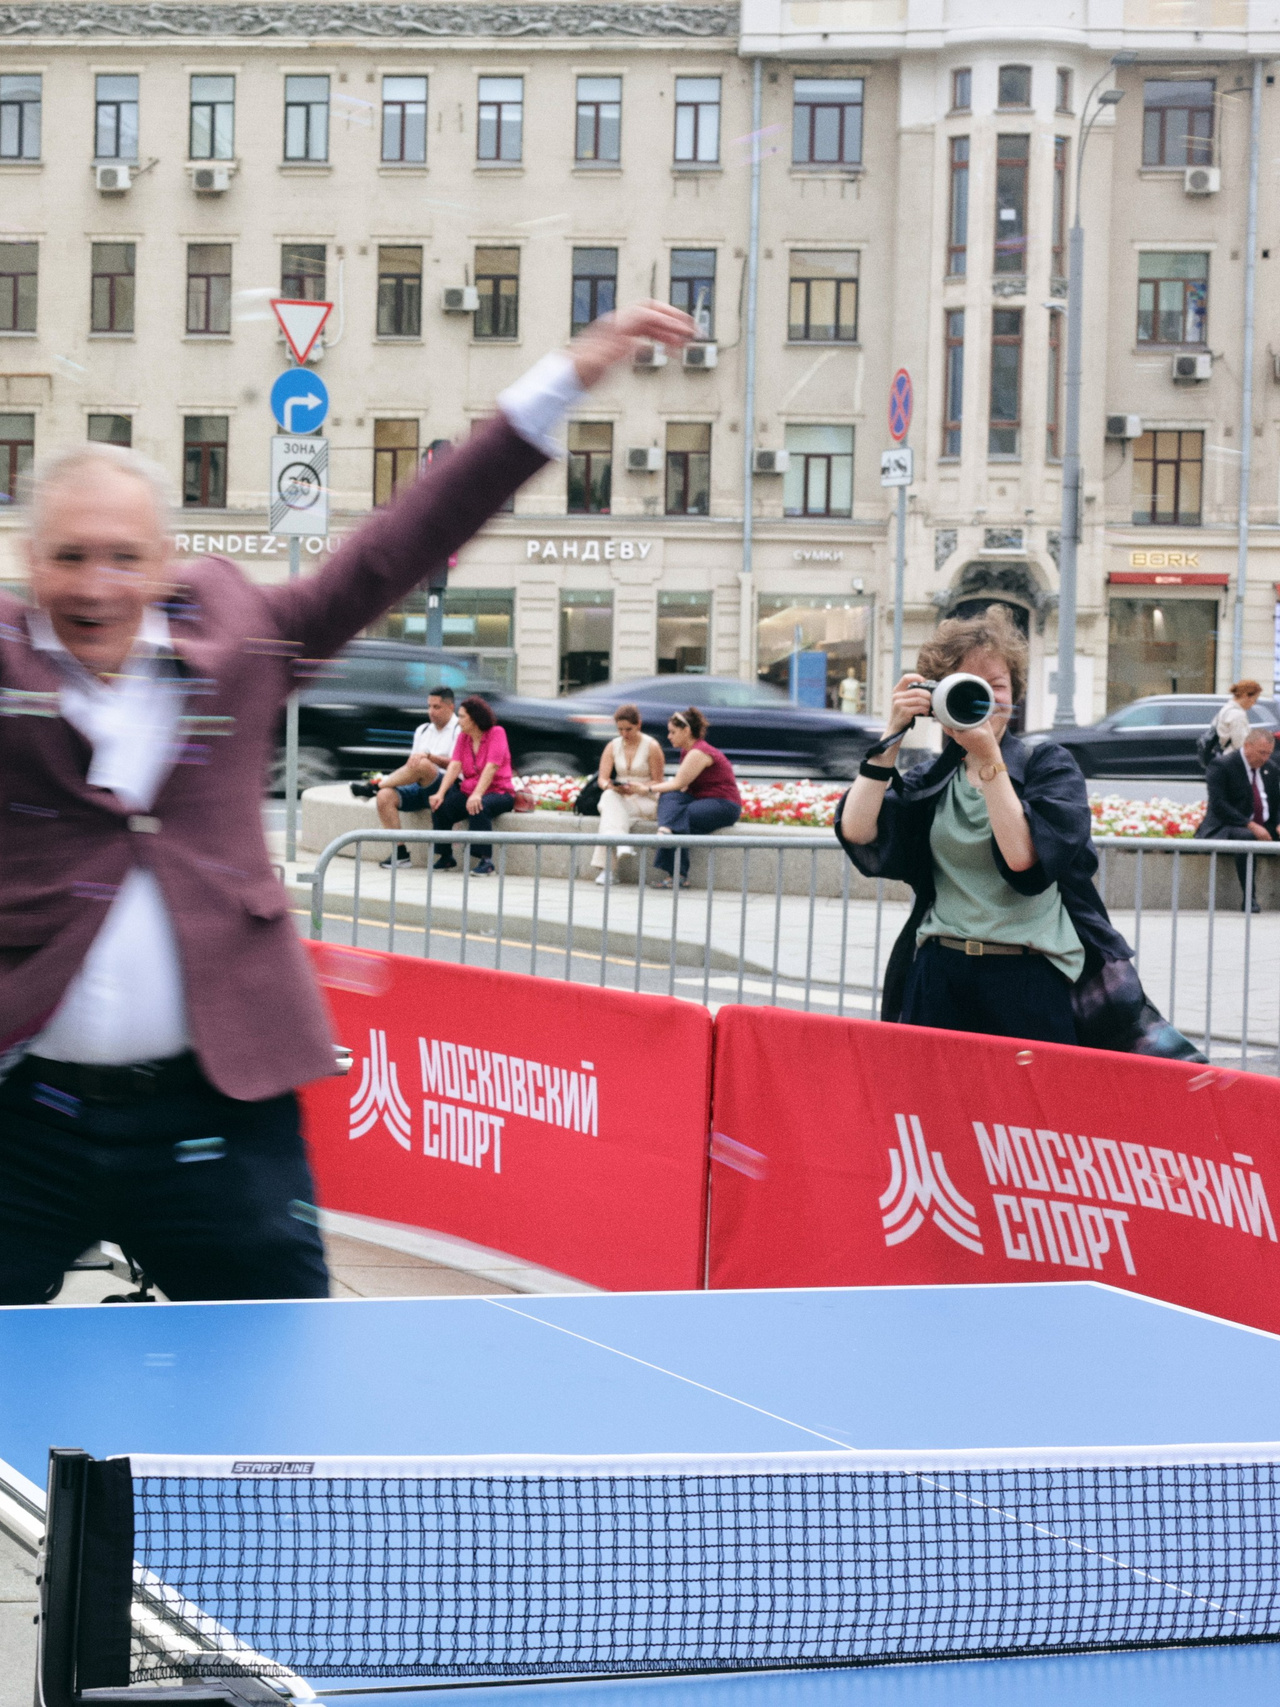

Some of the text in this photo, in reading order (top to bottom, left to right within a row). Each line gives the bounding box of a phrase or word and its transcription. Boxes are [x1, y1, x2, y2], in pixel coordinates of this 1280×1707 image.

[283, 443, 316, 454] ЗОНА
[175, 534, 341, 554] RENDEZ-OU
[526, 540, 651, 562] РАНДЕВУ
[792, 549, 843, 560] СУМКИ
[1130, 552, 1200, 567] BORK
[418, 1036, 598, 1137] МОСКОВСКИЙ
[423, 1099, 505, 1174] СПОРТ
[971, 1121, 1279, 1243] МОСКОВСКИЙ
[992, 1193, 1137, 1276] СПОРТ
[233, 1463, 312, 1473] START LINE
